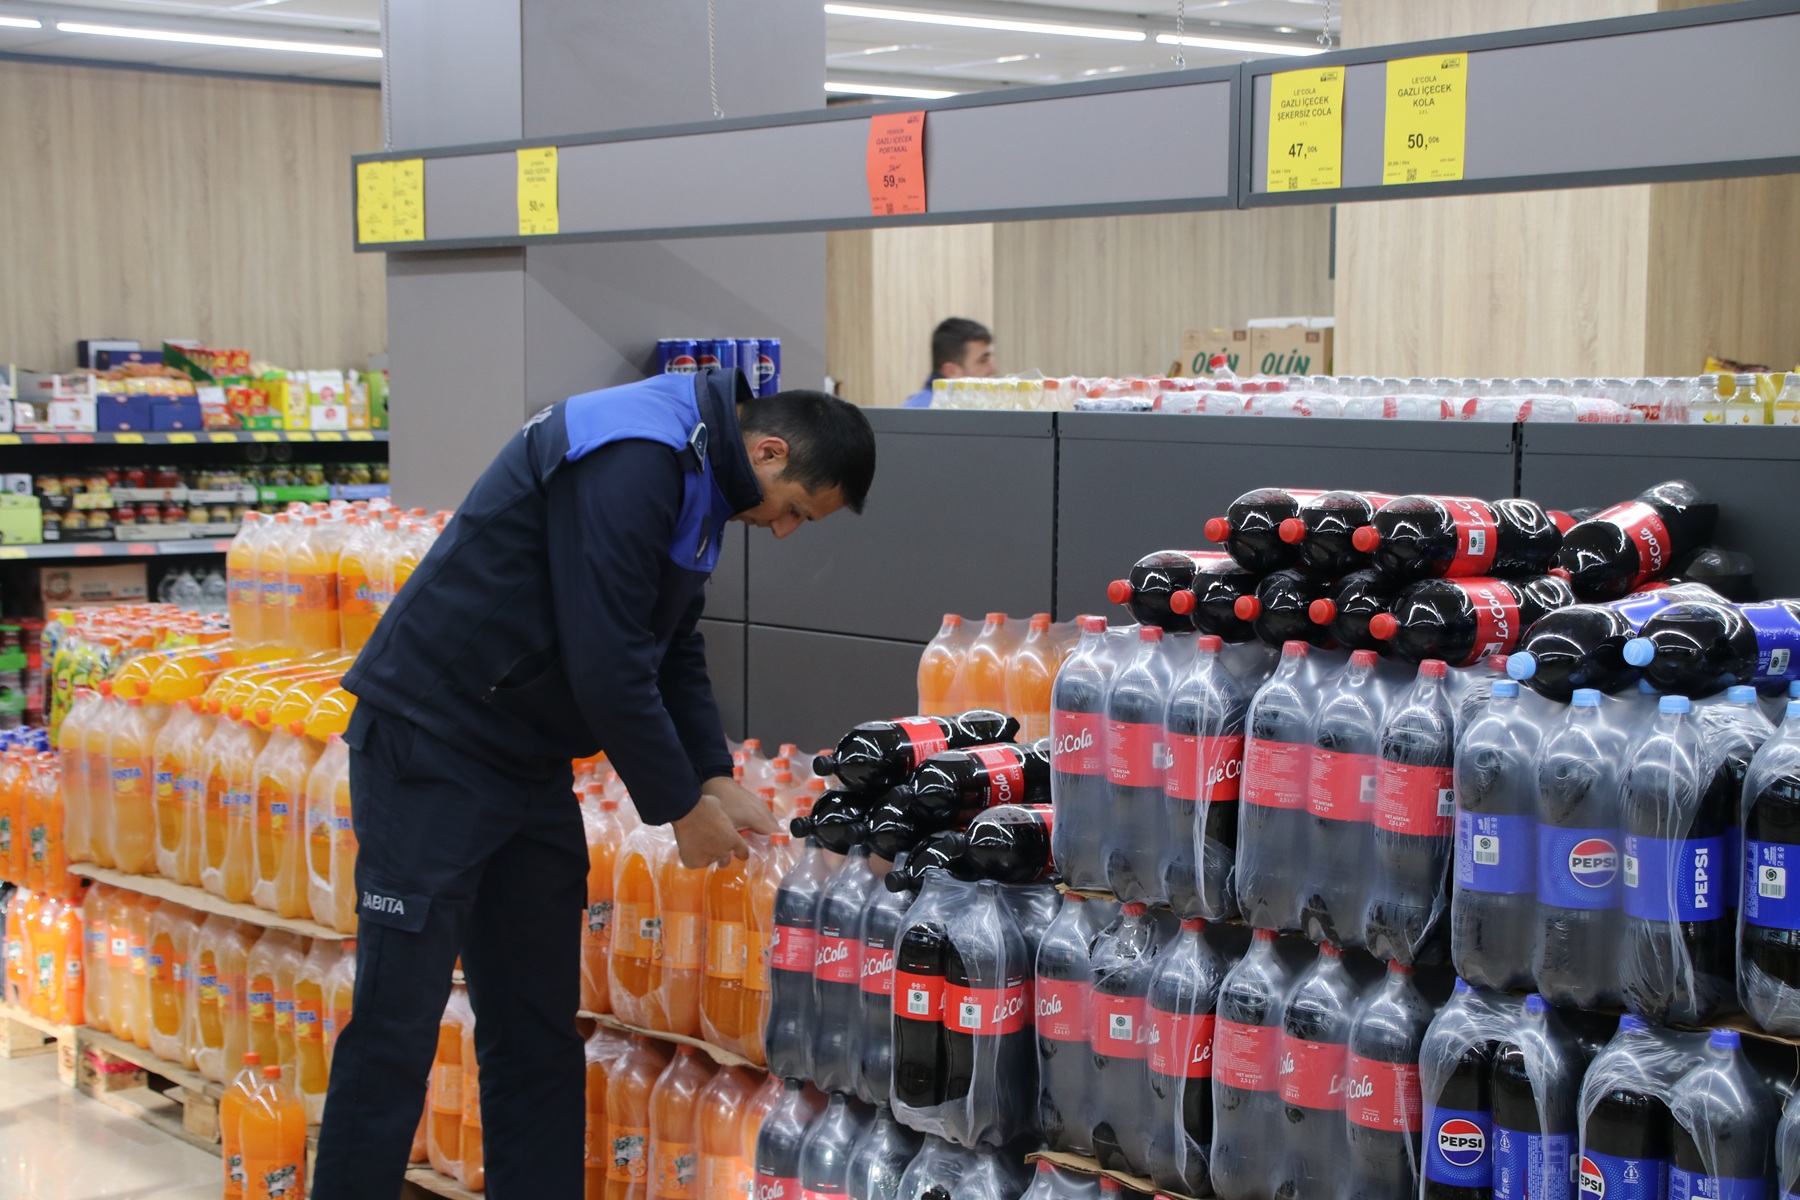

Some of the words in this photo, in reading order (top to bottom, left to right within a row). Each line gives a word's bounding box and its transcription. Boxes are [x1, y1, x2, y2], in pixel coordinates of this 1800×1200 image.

[1397, 87, 1421, 97] GAZLI
[1421, 83, 1452, 96] İÇECEK
[1280, 98, 1302, 109] GAZLI
[1412, 97, 1435, 108] KOLA
[1311, 107, 1332, 117] COLA
[1572, 857, 1617, 869] PEPSI
[1694, 848, 1708, 909] PEPSI
[1440, 1135, 1482, 1149] PEPSI
[1580, 1174, 1602, 1193] EPSI
